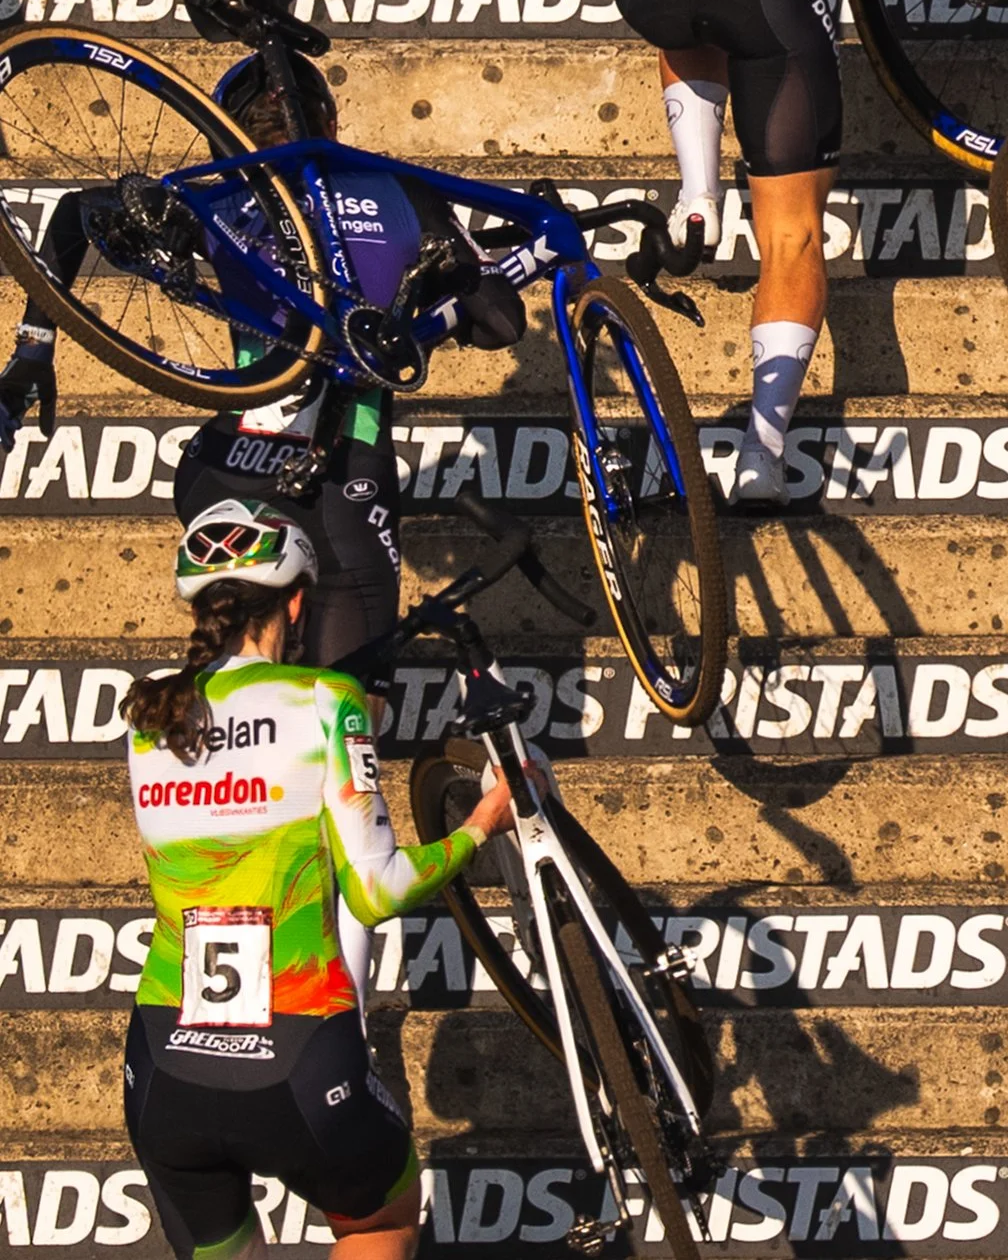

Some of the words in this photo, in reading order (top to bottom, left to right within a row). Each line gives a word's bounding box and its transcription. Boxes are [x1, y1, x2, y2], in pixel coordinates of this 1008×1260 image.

[361, 752, 379, 780] 5
[138, 771, 268, 809] corendon
[200, 941, 242, 1004] 5
